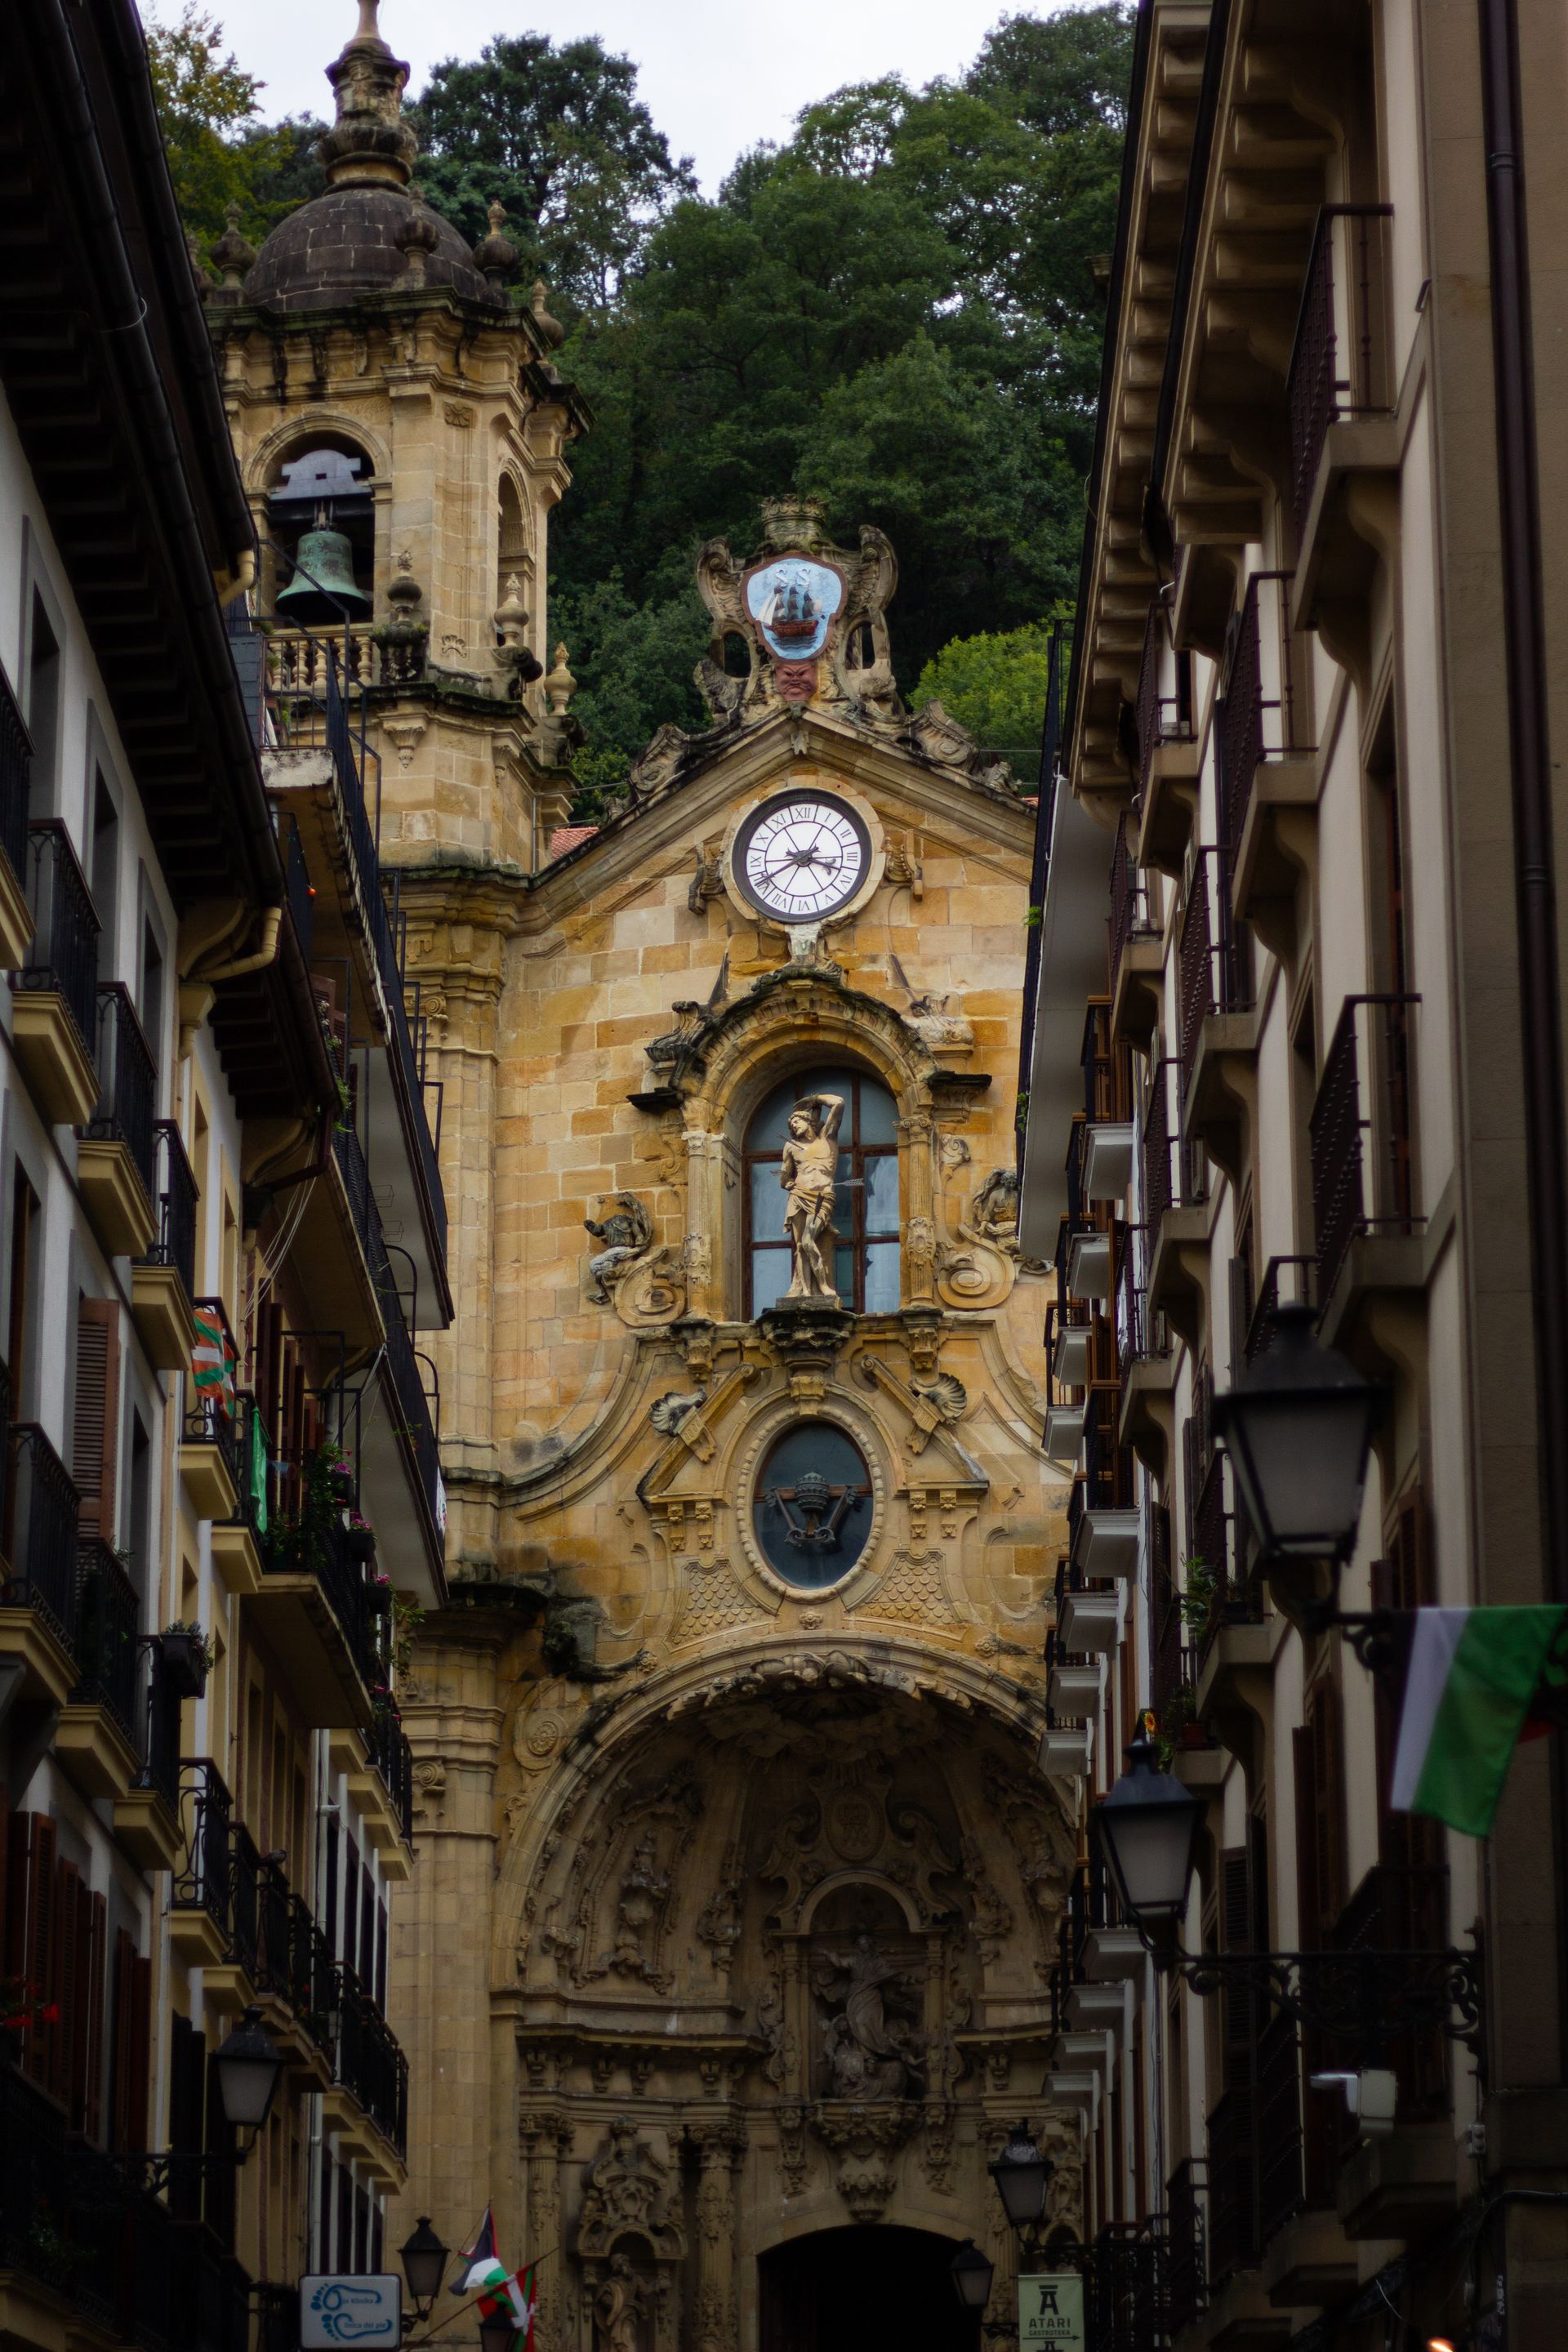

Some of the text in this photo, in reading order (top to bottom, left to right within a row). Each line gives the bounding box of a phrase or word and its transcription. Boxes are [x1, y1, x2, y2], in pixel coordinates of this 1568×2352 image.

[795, 807, 811, 819] XII
[772, 813, 787, 828] XI
[755, 831, 768, 844] X
[840, 827, 852, 839] II
[751, 855, 761, 868] IX
[846, 851, 858, 862] III
[839, 874, 852, 889] IV
[771, 893, 787, 909] VII
[823, 893, 834, 905] V
[798, 900, 810, 911] VI
[1028, 2318, 1071, 2328] ATARI
